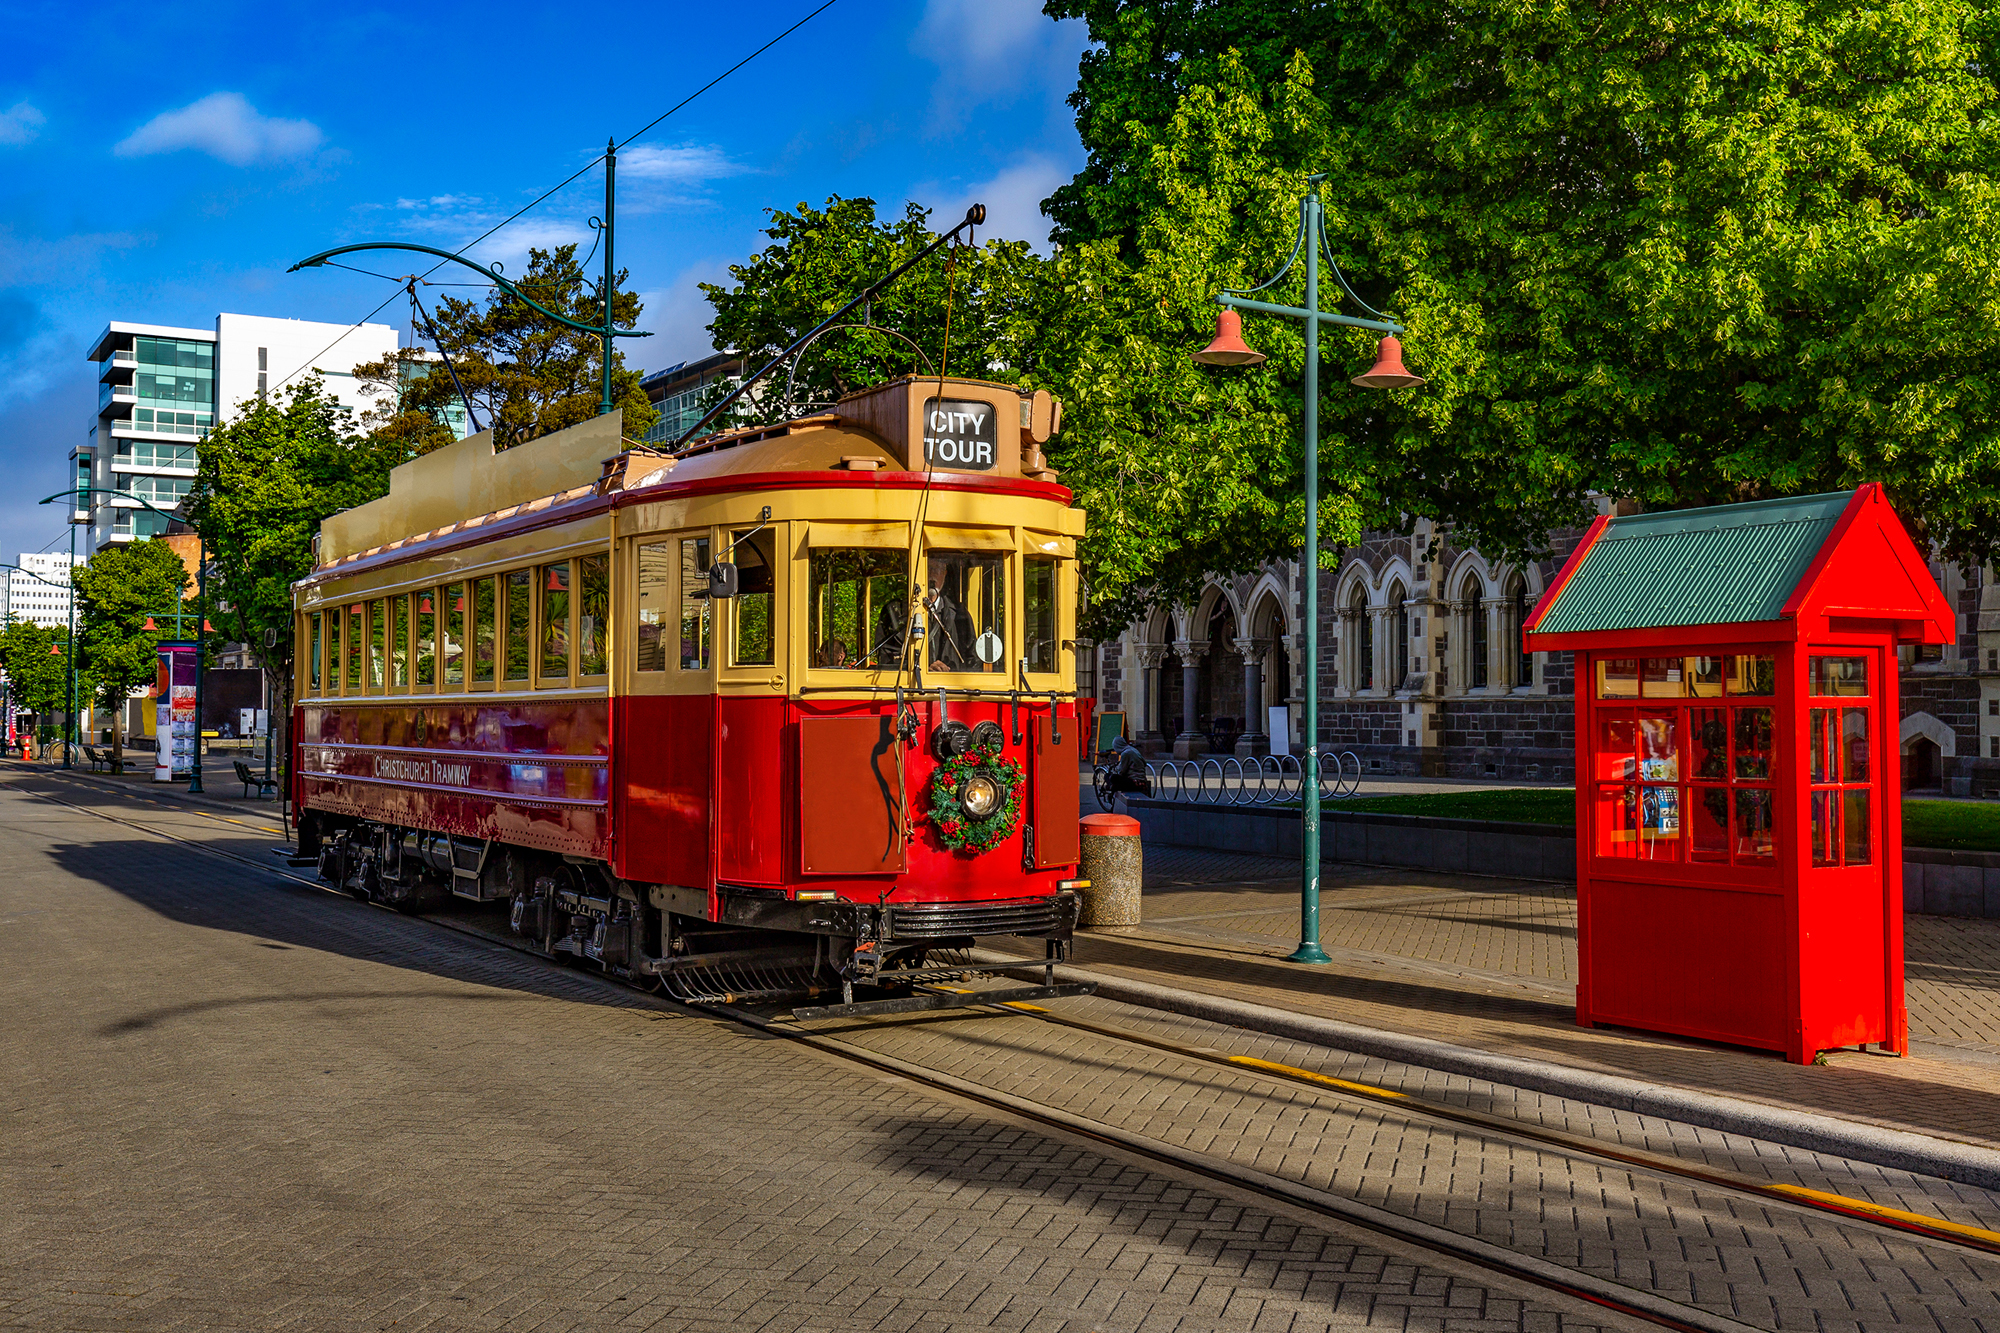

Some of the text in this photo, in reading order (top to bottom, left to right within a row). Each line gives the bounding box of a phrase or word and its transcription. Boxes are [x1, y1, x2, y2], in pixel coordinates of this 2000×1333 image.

[930, 410, 985, 435] CITY
[924, 437, 992, 464] TOUR
[432, 759, 471, 786] TRAMWAY
